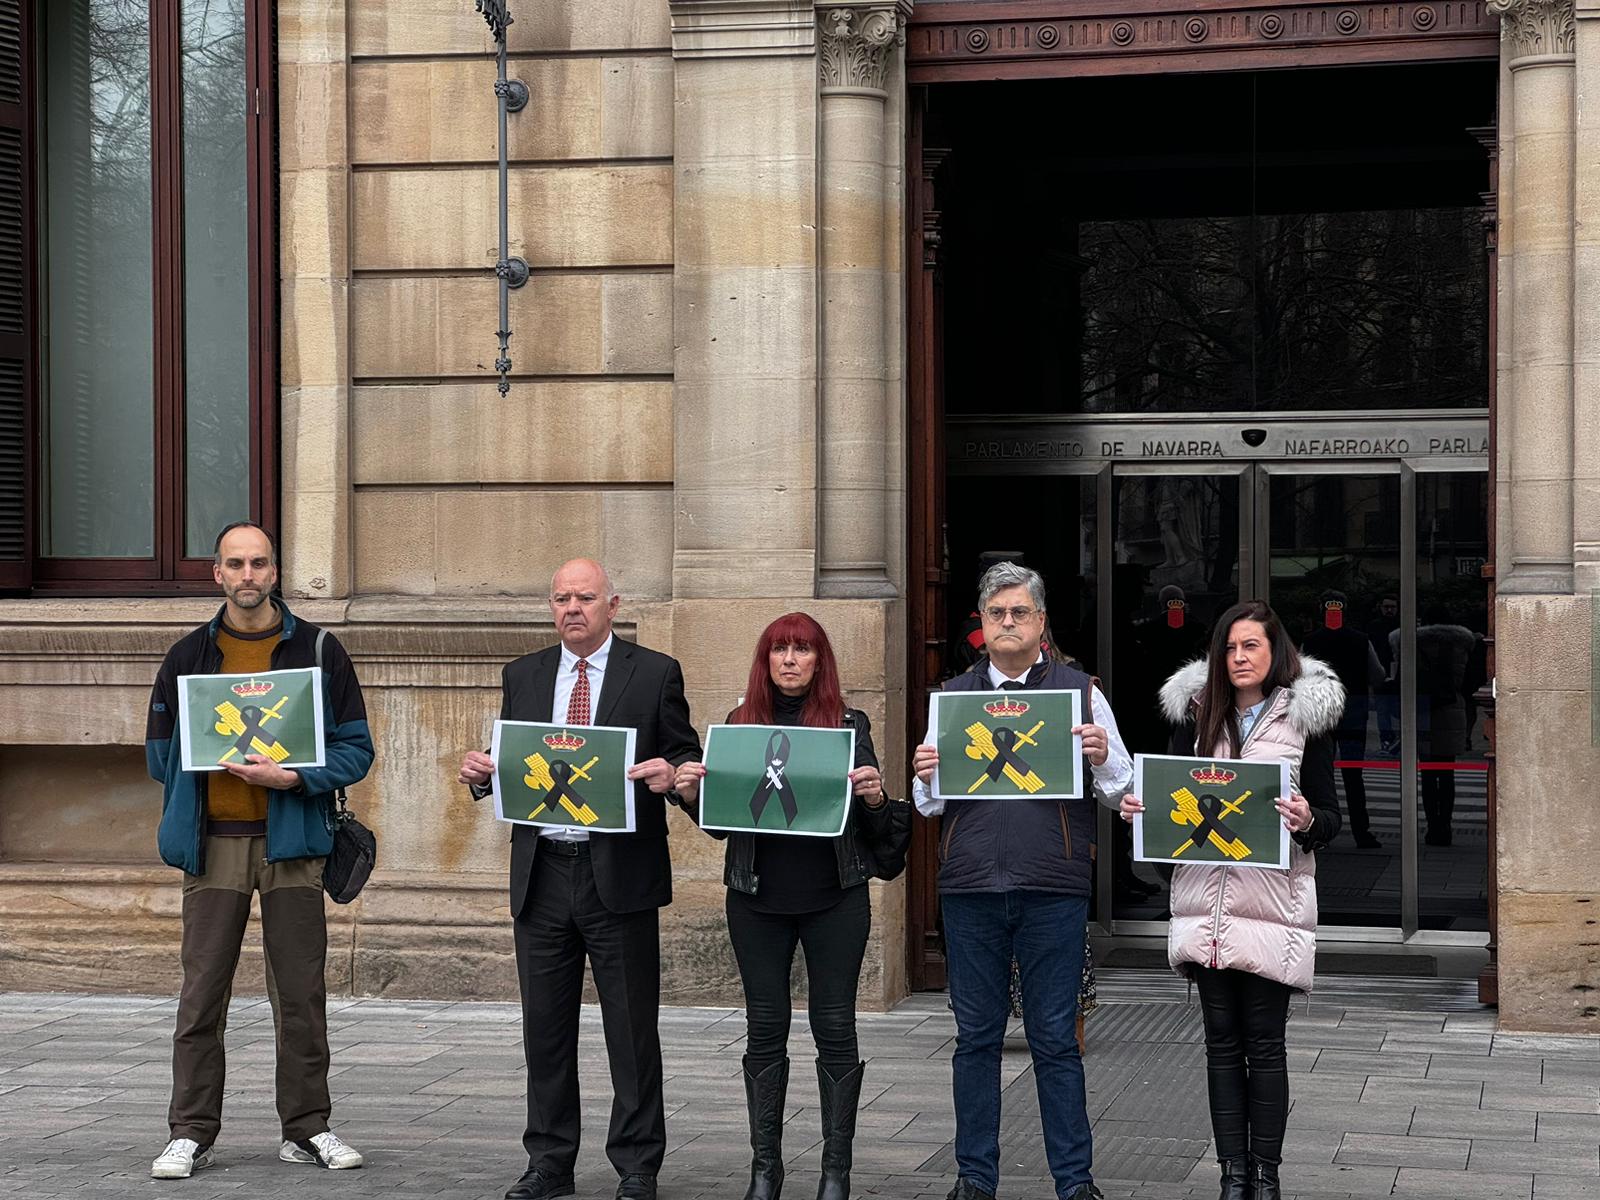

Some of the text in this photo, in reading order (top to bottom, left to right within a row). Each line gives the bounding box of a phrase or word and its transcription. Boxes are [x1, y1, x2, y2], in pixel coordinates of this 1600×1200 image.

[965, 441, 1083, 457] PARLAMENTO
[1101, 442, 1124, 457] DE
[1142, 441, 1225, 457] NAVARRA
[1285, 439, 1410, 455] NAFARROAKO
